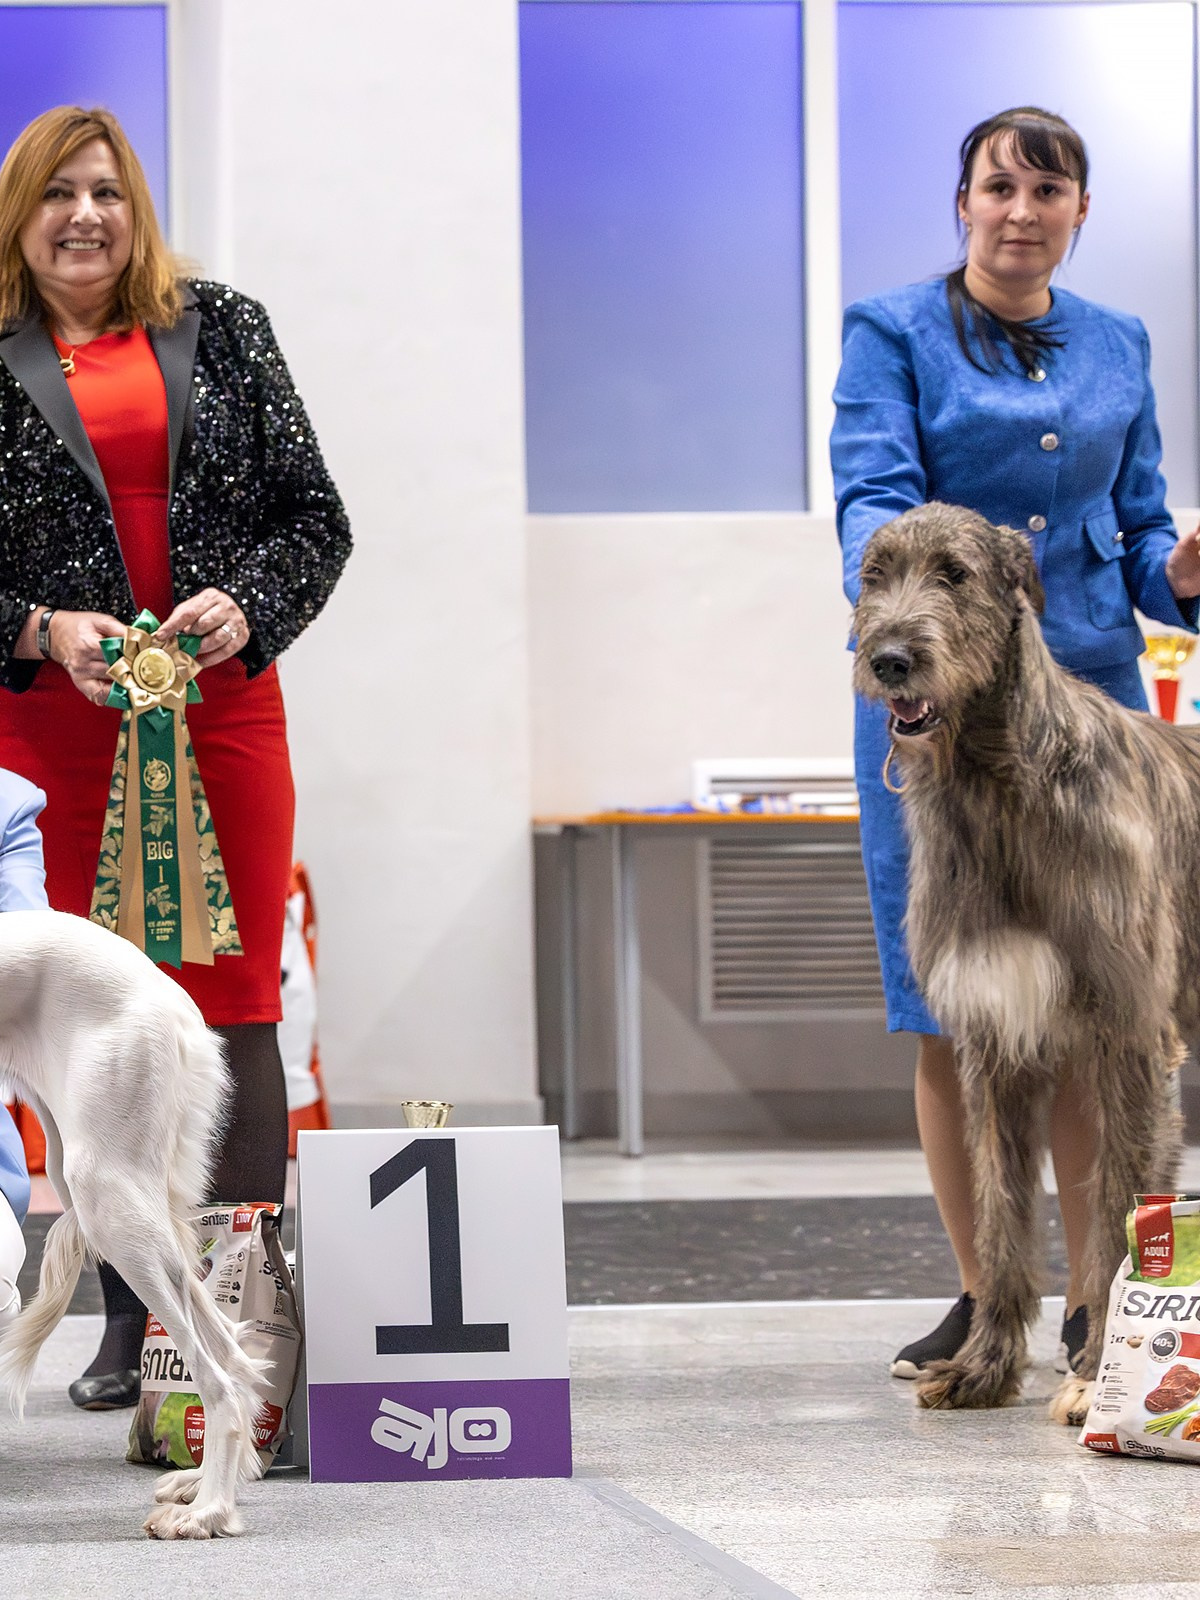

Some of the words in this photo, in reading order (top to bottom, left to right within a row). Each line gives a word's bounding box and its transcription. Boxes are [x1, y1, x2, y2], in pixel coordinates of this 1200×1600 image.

[146, 841, 174, 861] BIG
[369, 1138, 510, 1355] 1
[1144, 1246, 1171, 1257] ADULT
[1123, 1290, 1200, 1322] SIRI
